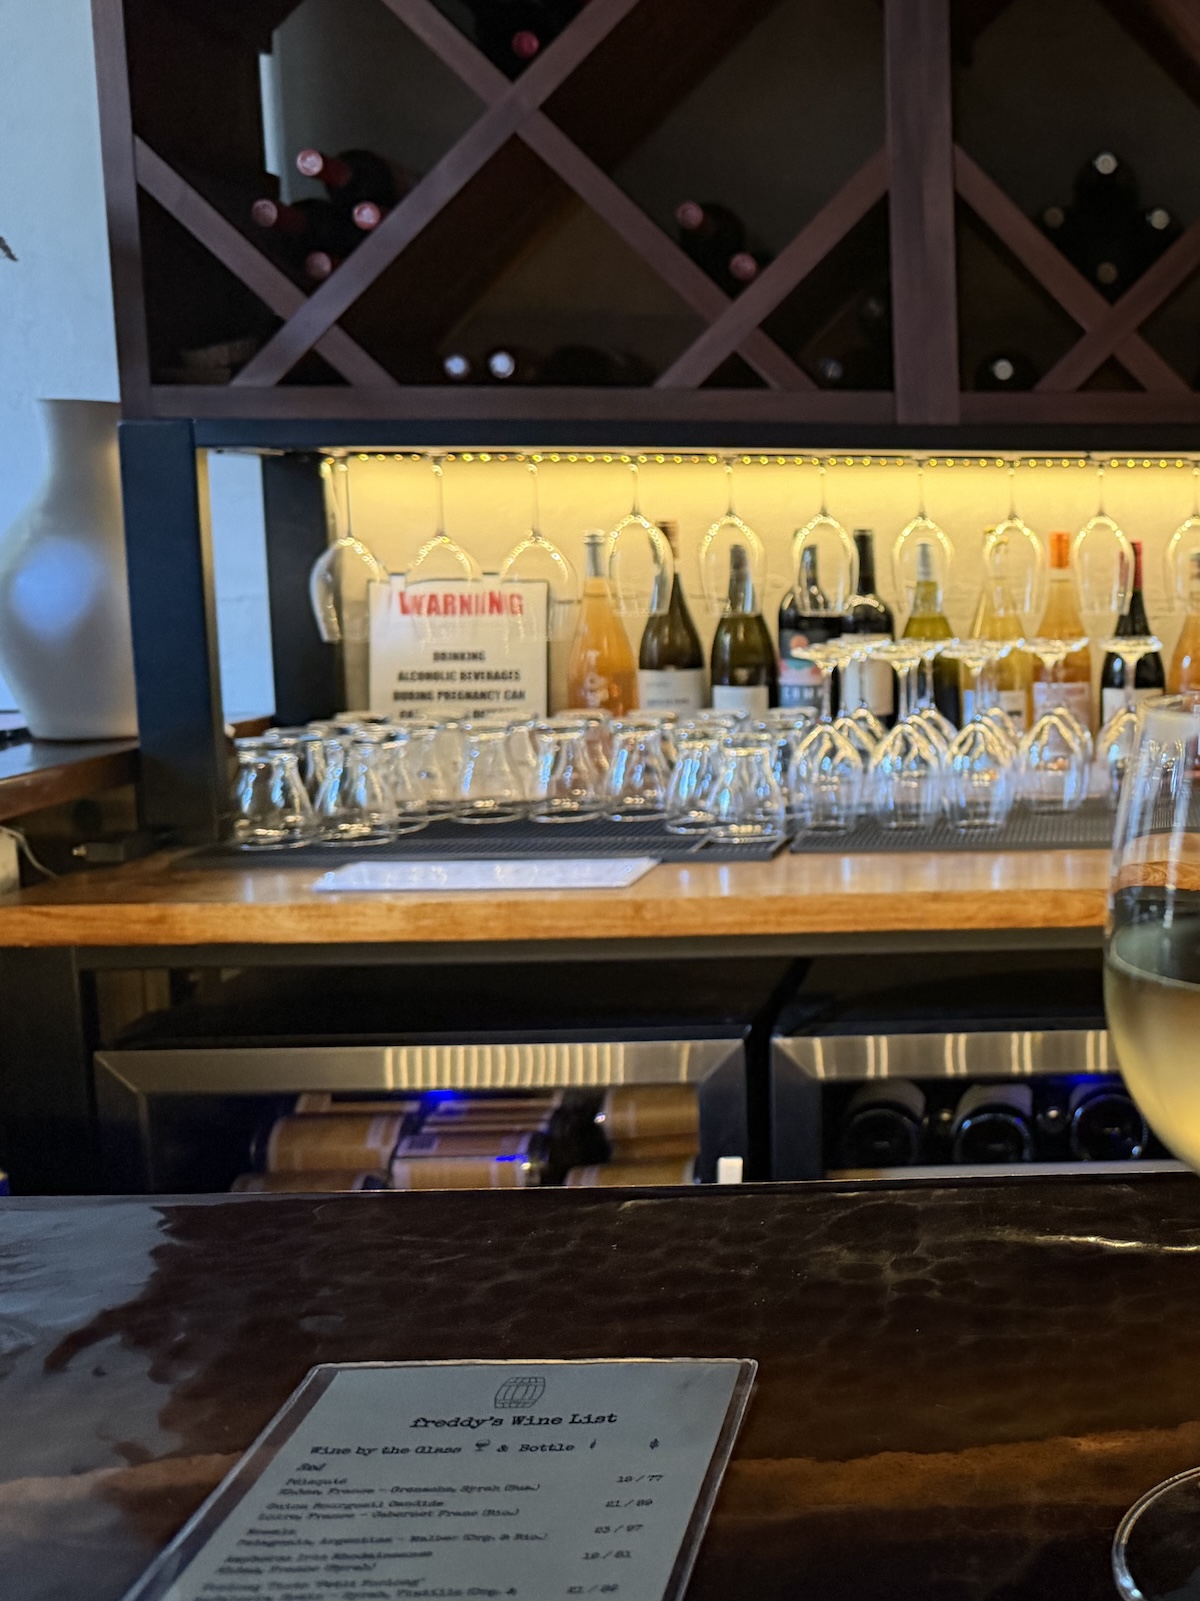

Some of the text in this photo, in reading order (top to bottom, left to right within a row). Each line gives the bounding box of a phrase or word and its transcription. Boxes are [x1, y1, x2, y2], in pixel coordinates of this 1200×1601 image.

[398, 591, 524, 617] WARNING
[433, 651, 486, 661] DRINKING
[398, 670, 521, 682] ALCOHOLIC BEVERAGES
[393, 690, 526, 701] DURING PREGNANCY CAN
[410, 1413, 618, 1429] freddy's Wine List
[310, 1446, 351, 1455] Wine
[355, 1446, 376, 1457] by
[381, 1446, 410, 1455] the
[415, 1446, 462, 1455] Glass
[518, 1443, 576, 1452] Bottle
[647, 1474, 664, 1482] 77
